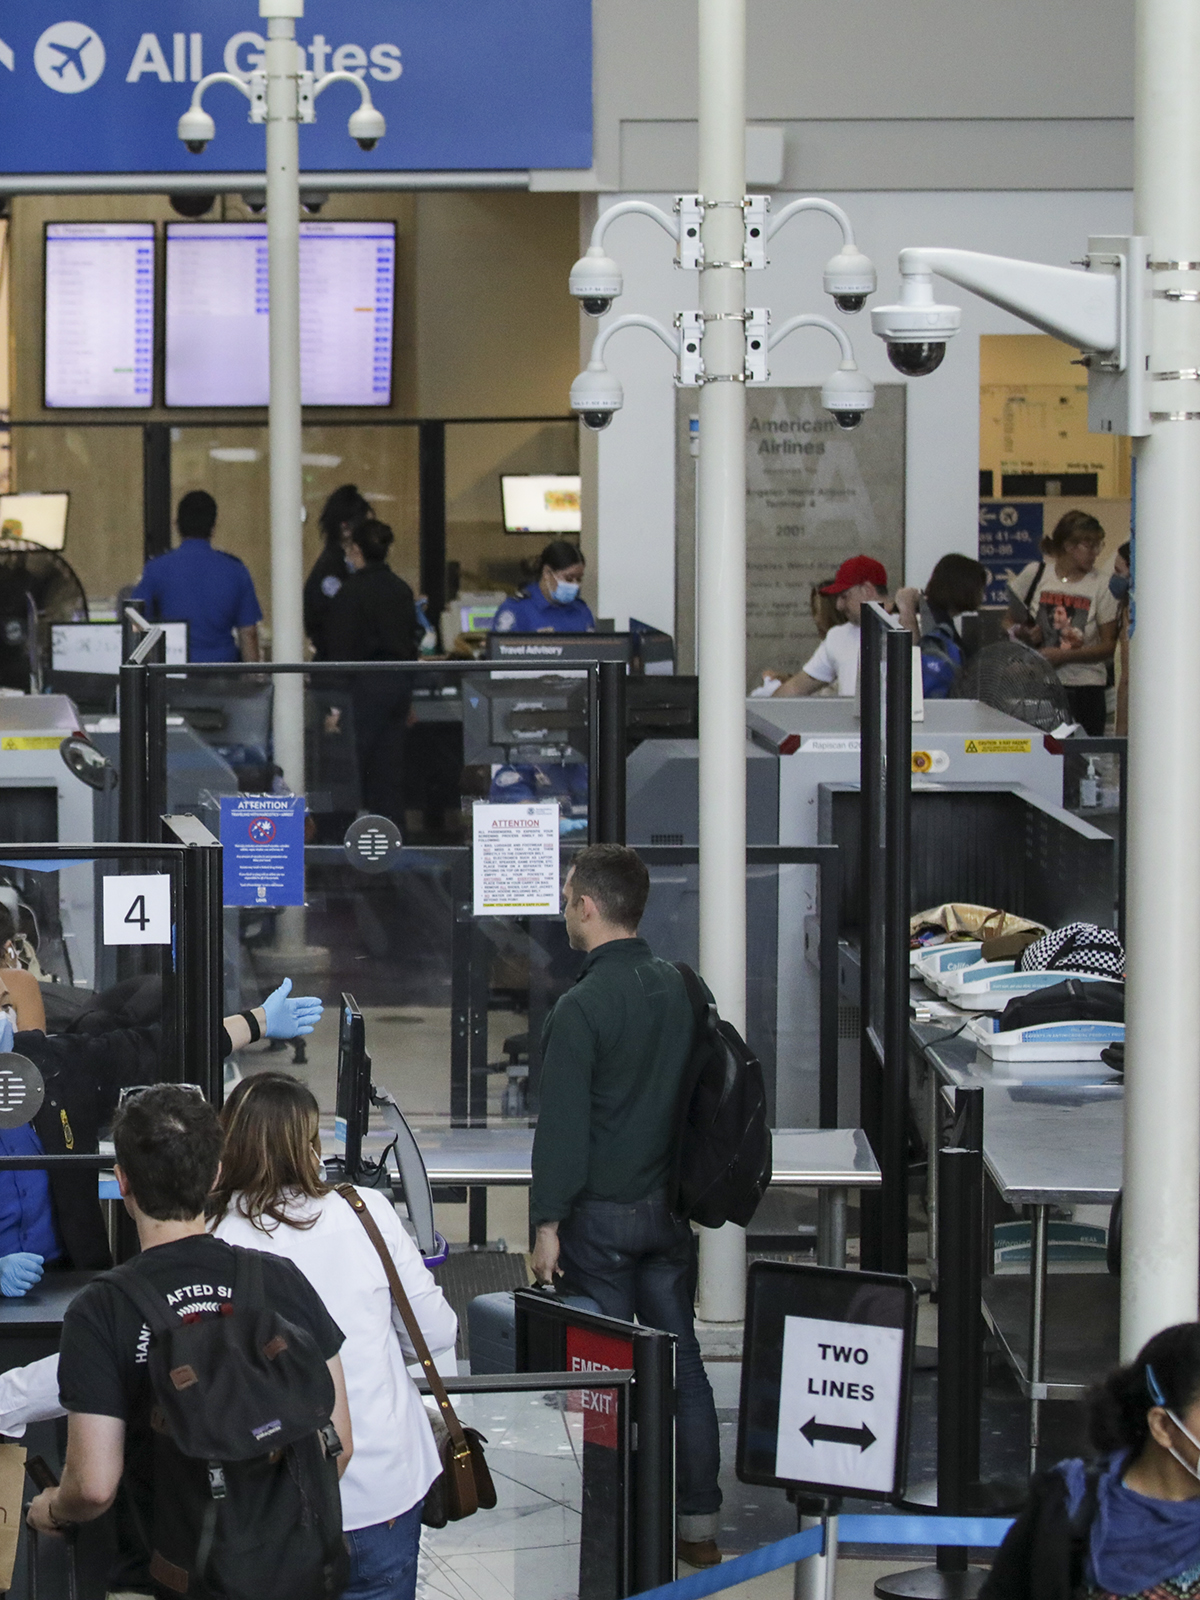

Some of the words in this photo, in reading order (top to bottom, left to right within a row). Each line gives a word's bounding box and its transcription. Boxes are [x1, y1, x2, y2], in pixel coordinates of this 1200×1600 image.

[125, 32, 203, 83] All
[223, 31, 404, 83] Gtes
[749, 417, 834, 433] American
[757, 439, 825, 455] Airlines
[499, 645, 526, 655] Travel
[525, 645, 563, 657] Advisory
[812, 741, 847, 750] Rapiscan
[238, 801, 288, 810] ATTENTION
[492, 819, 540, 828] ATTENTION
[124, 894, 151, 931] 4
[166, 1284, 213, 1306] AFTED
[135, 1323, 151, 1363] HAN
[818, 1343, 869, 1365] TWO
[807, 1378, 874, 1402] LINES
[581, 1389, 612, 1414] EXIT
